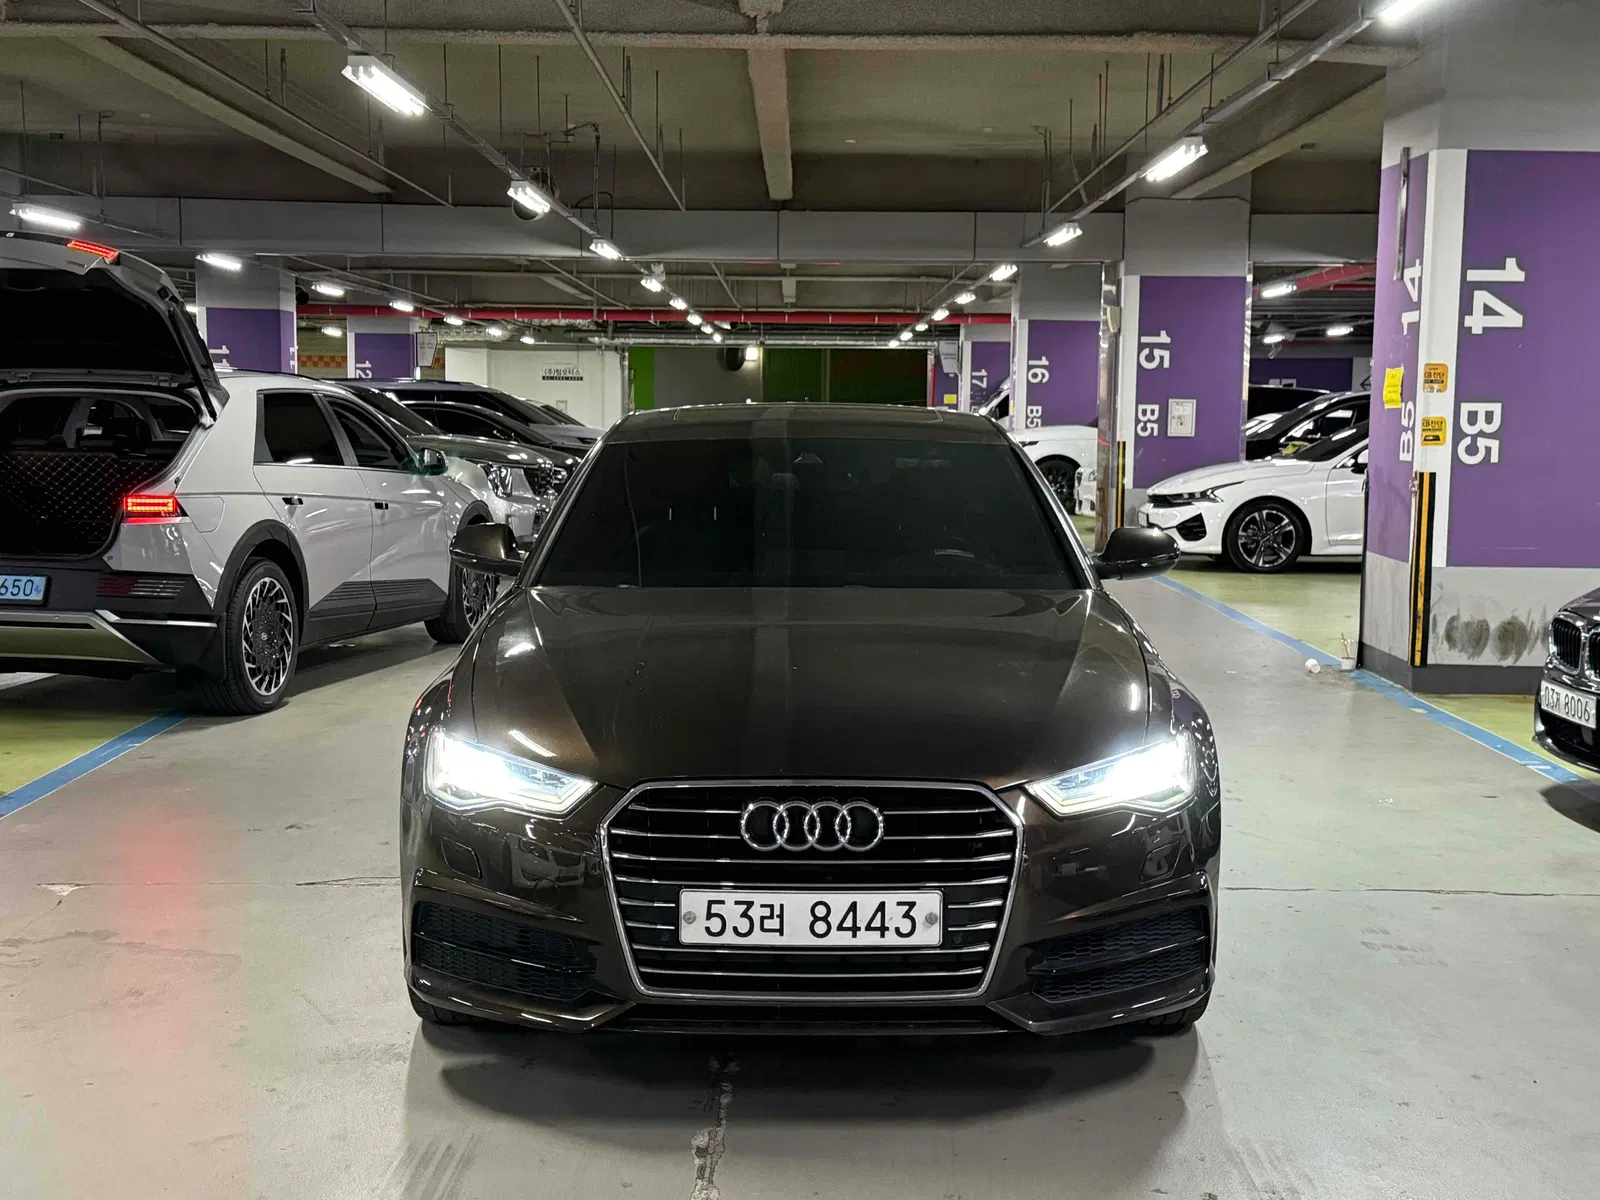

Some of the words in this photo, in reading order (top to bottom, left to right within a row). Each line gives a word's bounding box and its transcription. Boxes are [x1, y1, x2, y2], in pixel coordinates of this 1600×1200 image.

[1401, 258, 1423, 336] 14
[1463, 257, 1526, 335] 14
[1139, 329, 1172, 370] 15
[355, 360, 373, 379] 12
[971, 368, 988, 389] 17
[1027, 356, 1051, 384] 16
[1026, 405, 1042, 428] B5
[1136, 404, 1160, 437] B5
[1398, 400, 1415, 462] B5
[1457, 402, 1502, 465] B5
[1564, 693, 1591, 722] 8006
[704, 899, 785, 938] 53러
[808, 900, 917, 939] 8443
